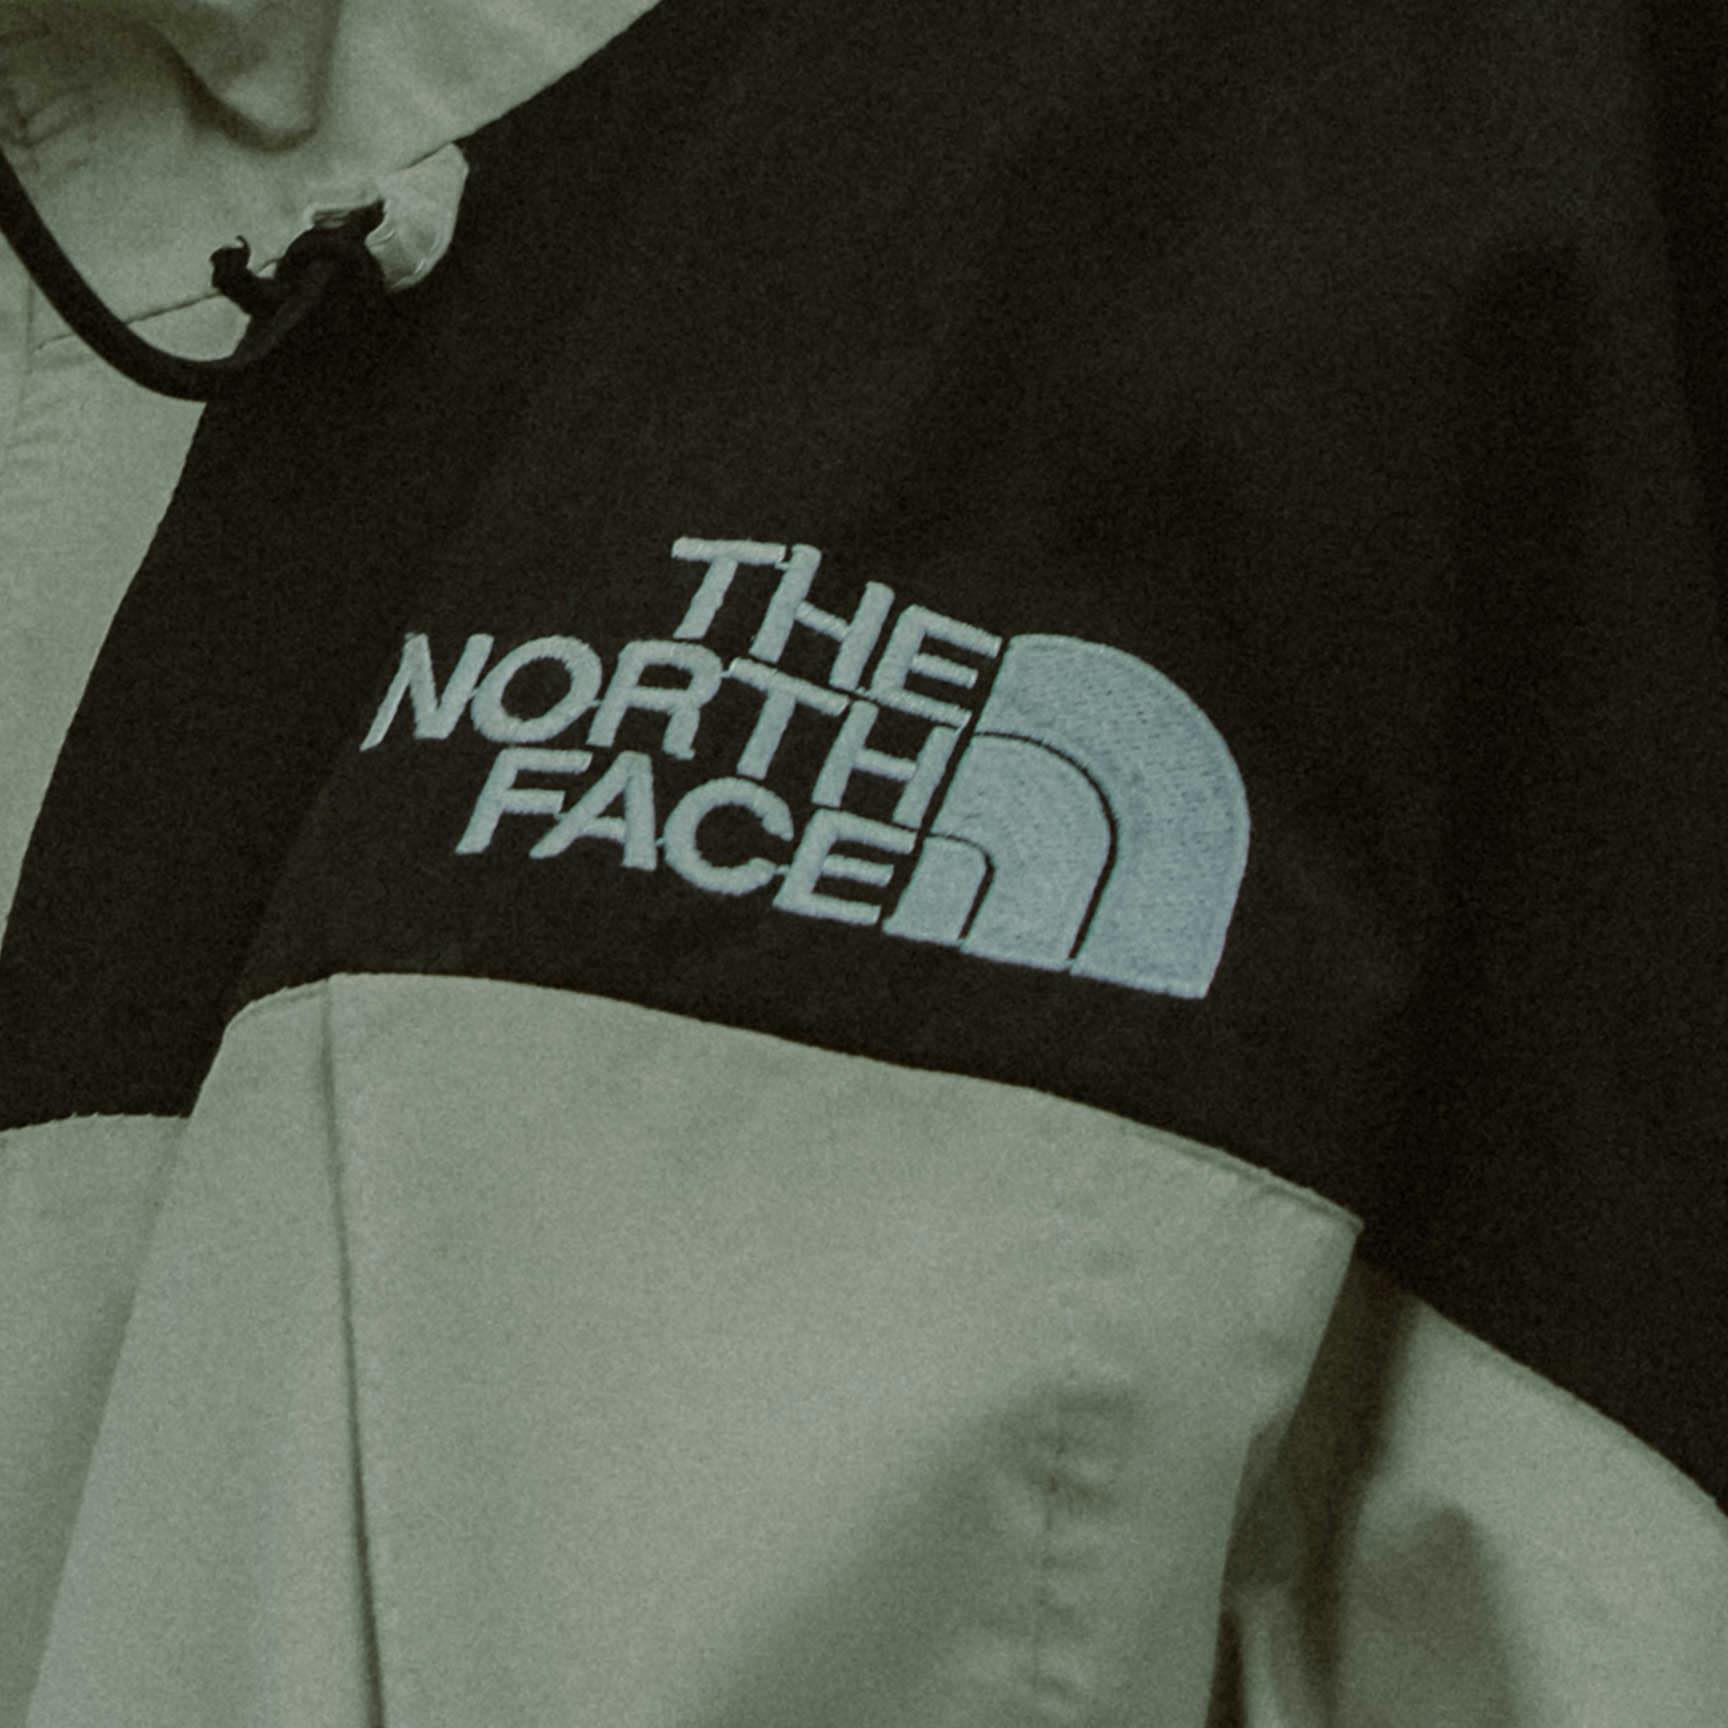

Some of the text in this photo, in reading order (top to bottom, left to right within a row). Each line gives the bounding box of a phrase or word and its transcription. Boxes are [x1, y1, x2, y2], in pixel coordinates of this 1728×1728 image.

[673, 537, 1002, 727] THE
[361, 634, 958, 828] NORTH
[457, 749, 915, 926] FACE
